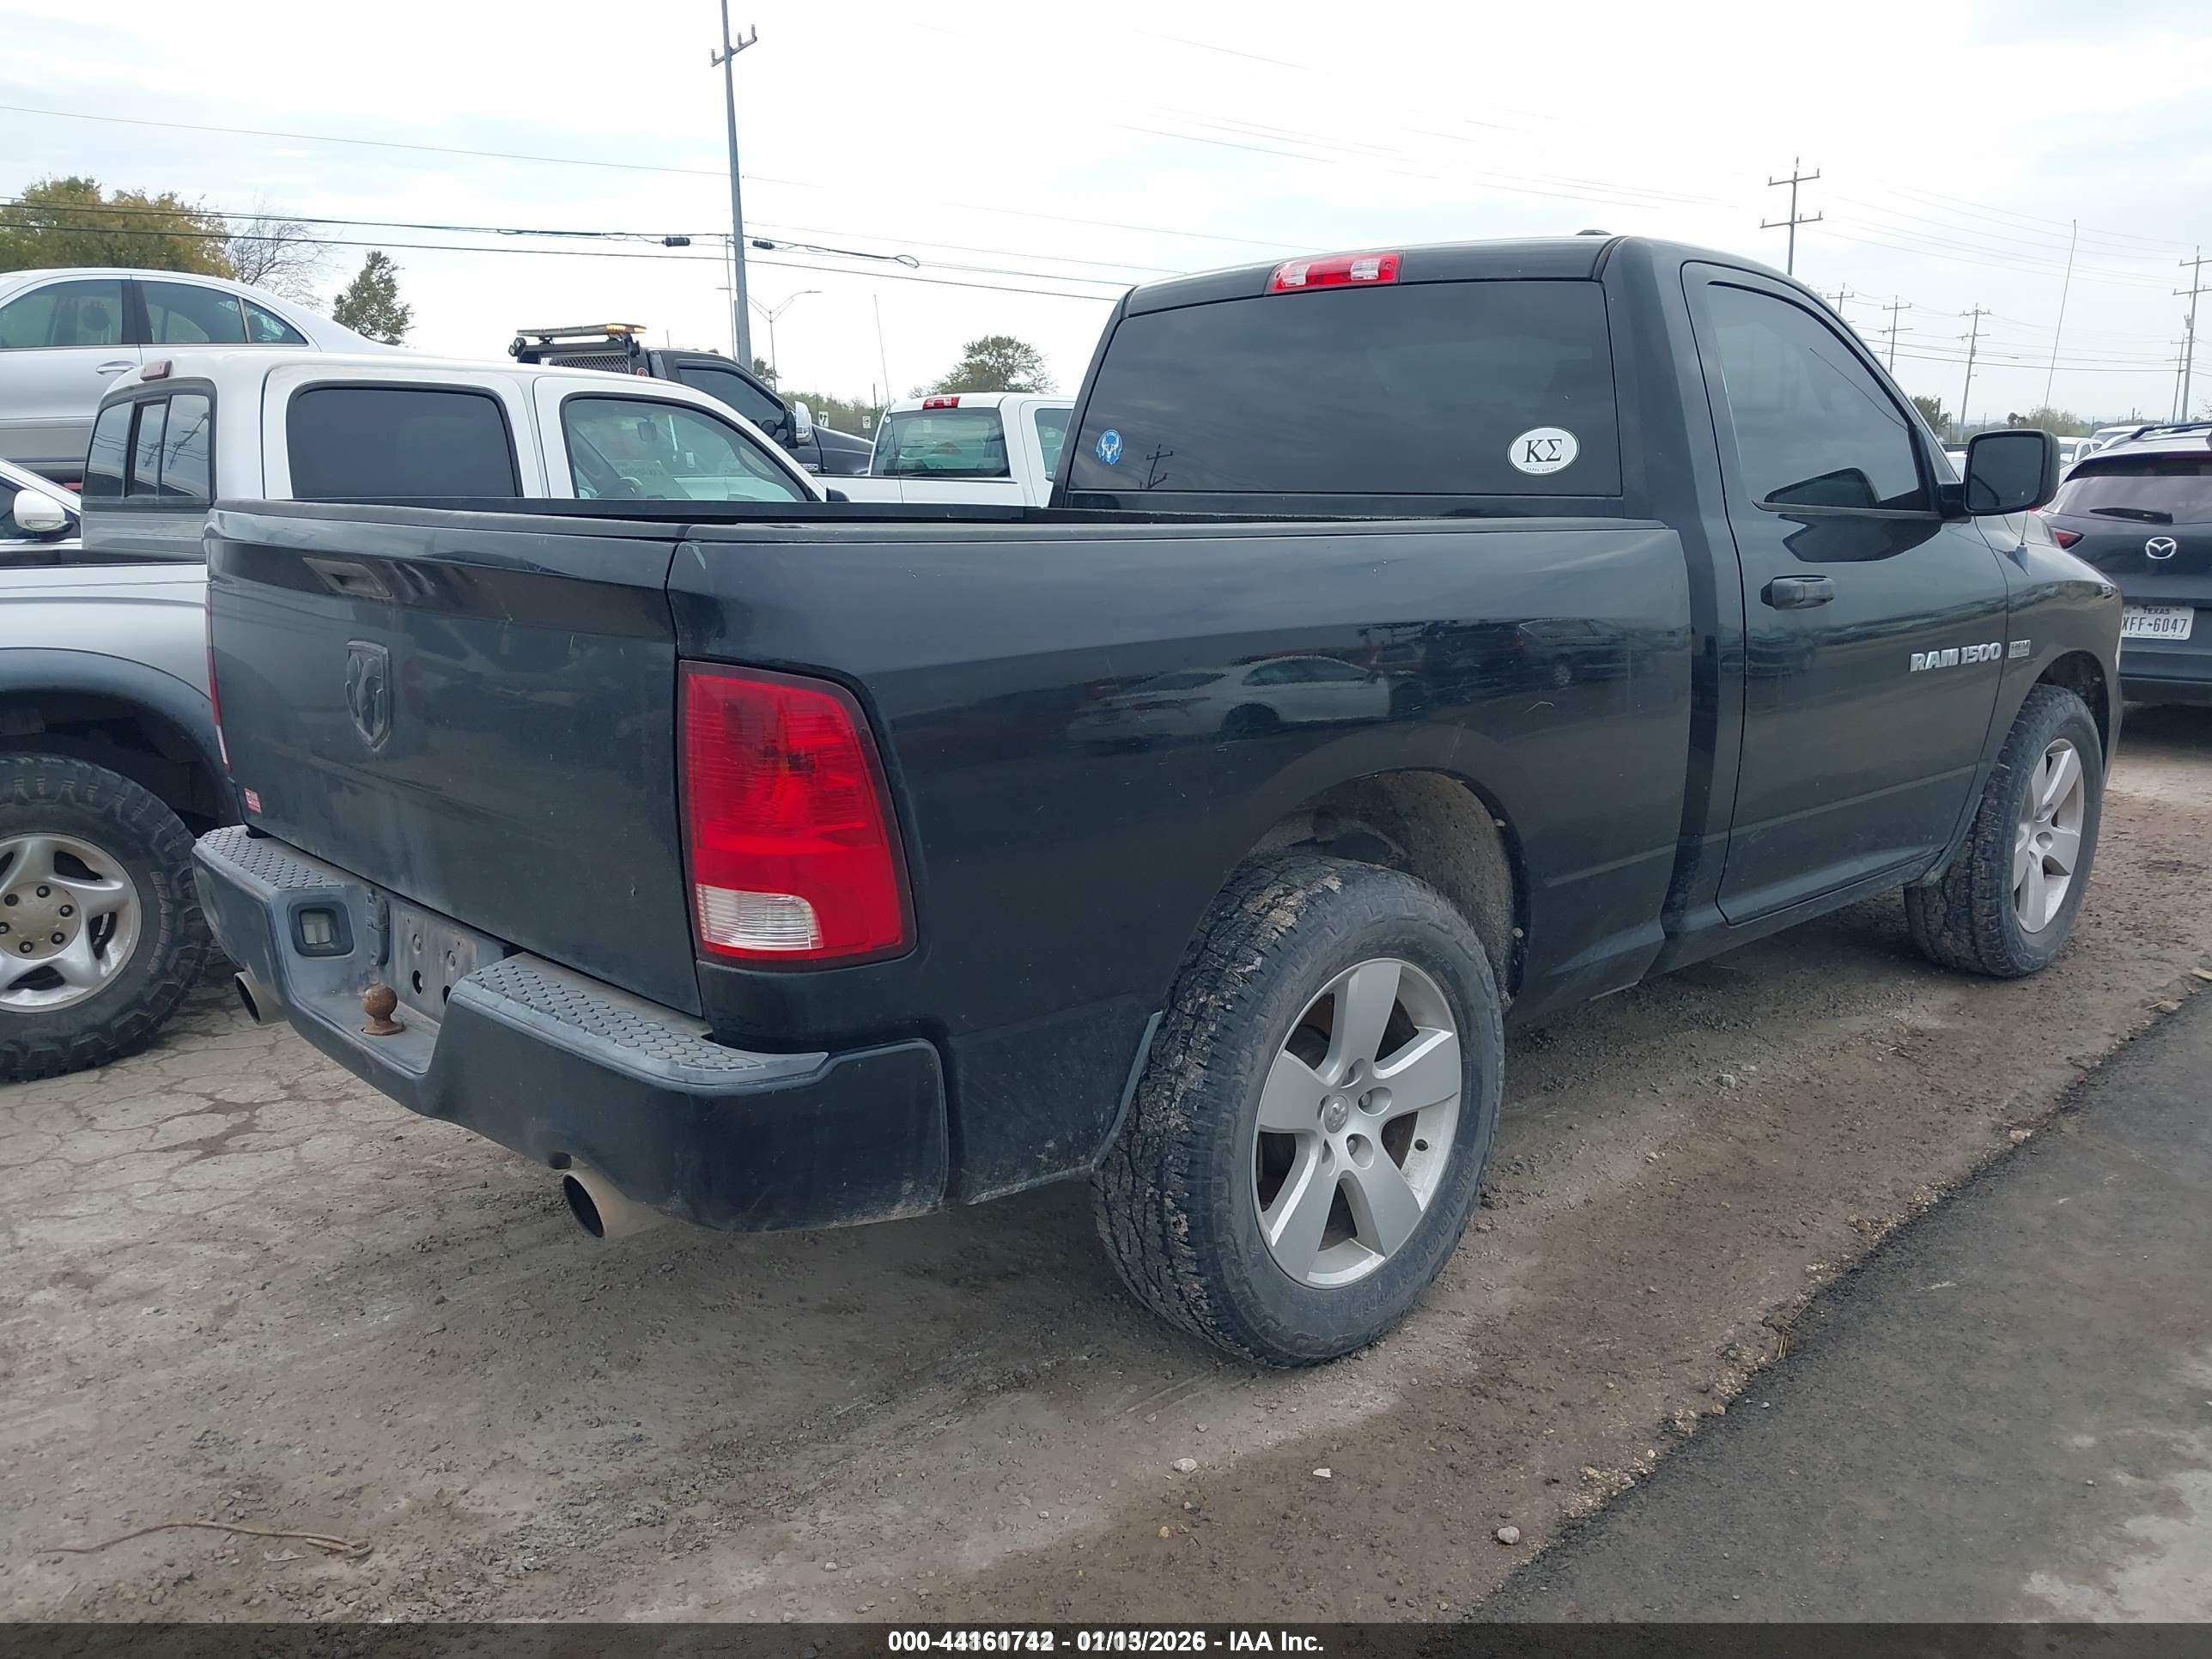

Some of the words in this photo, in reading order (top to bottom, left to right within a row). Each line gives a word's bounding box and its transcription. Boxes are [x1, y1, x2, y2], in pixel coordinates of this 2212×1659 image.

[2143, 606, 2171, 615] TEXAS
[1910, 648, 1960, 672] RAM
[1960, 642, 2002, 665] 1500
